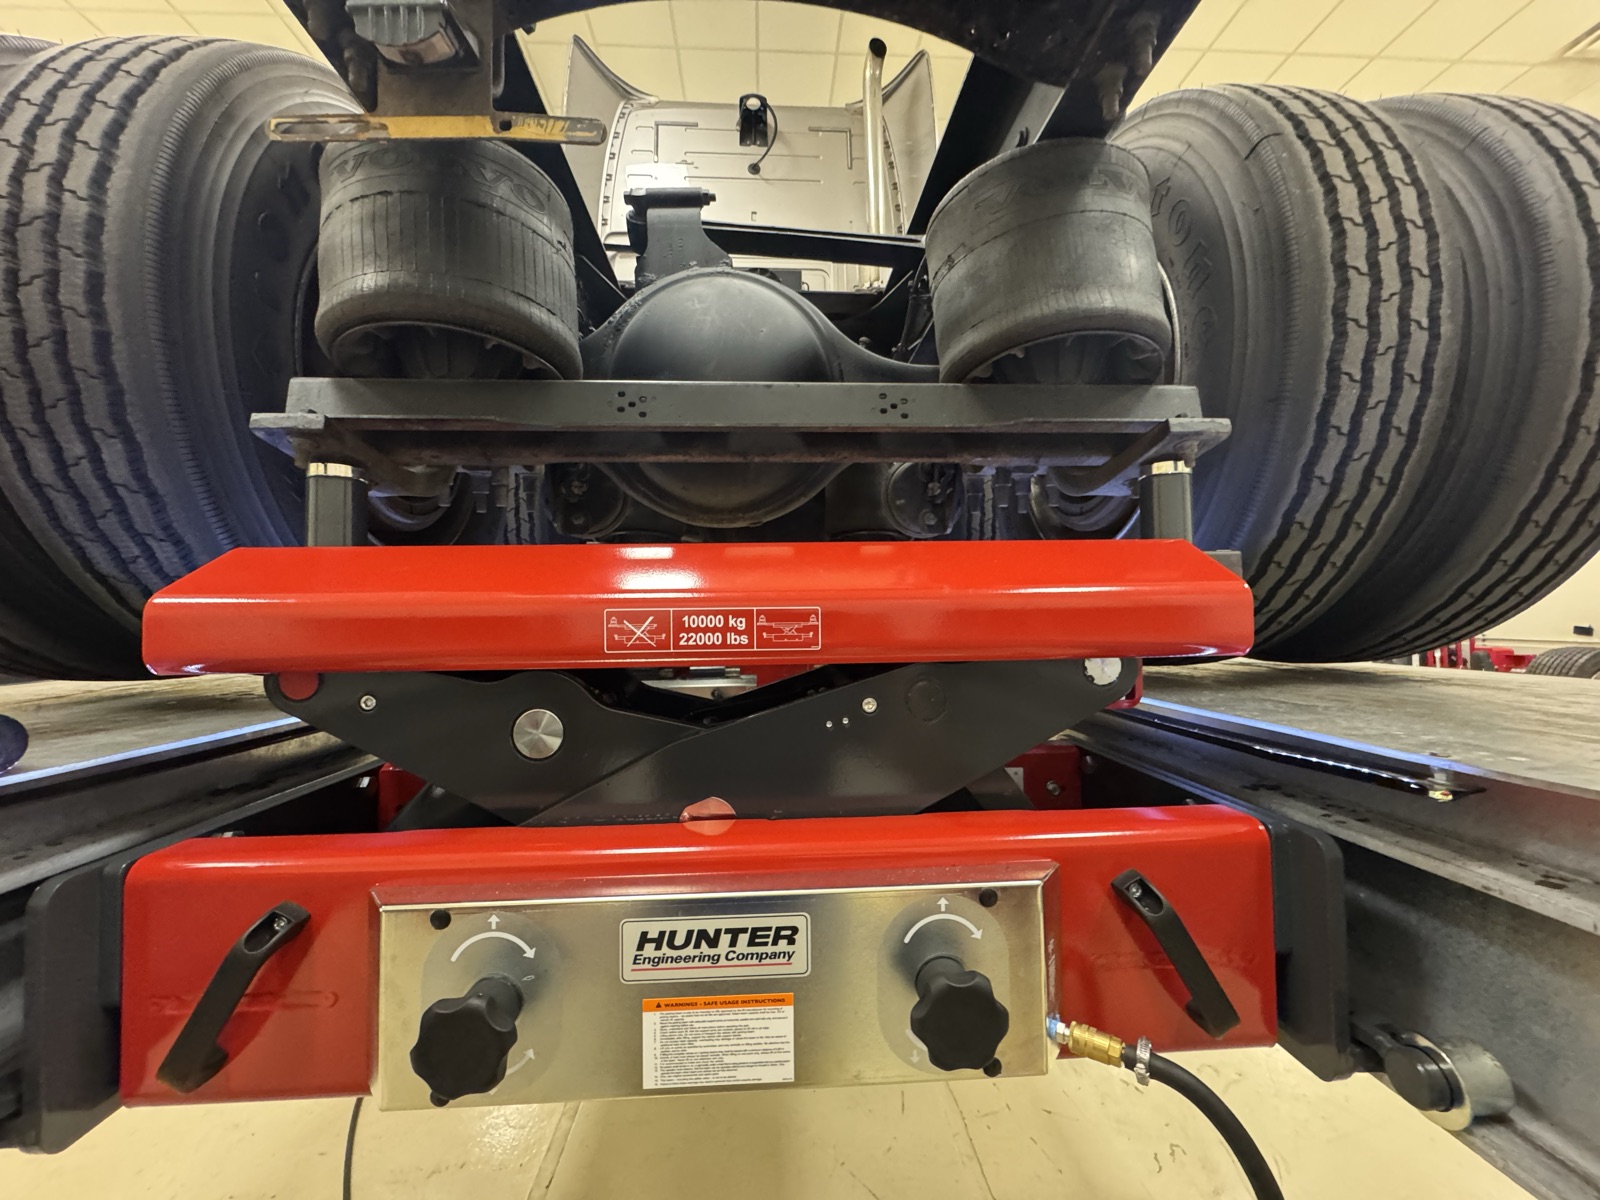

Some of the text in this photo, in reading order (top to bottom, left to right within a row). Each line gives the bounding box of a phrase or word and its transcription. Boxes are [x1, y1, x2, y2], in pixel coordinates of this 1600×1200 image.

[329, 147, 546, 214] VOVO
[682, 614, 746, 631] 10000 kg
[679, 632, 749, 645] 22000 lbs
[635, 925, 800, 952] HUNTER
[632, 950, 796, 967] Engineering Company
